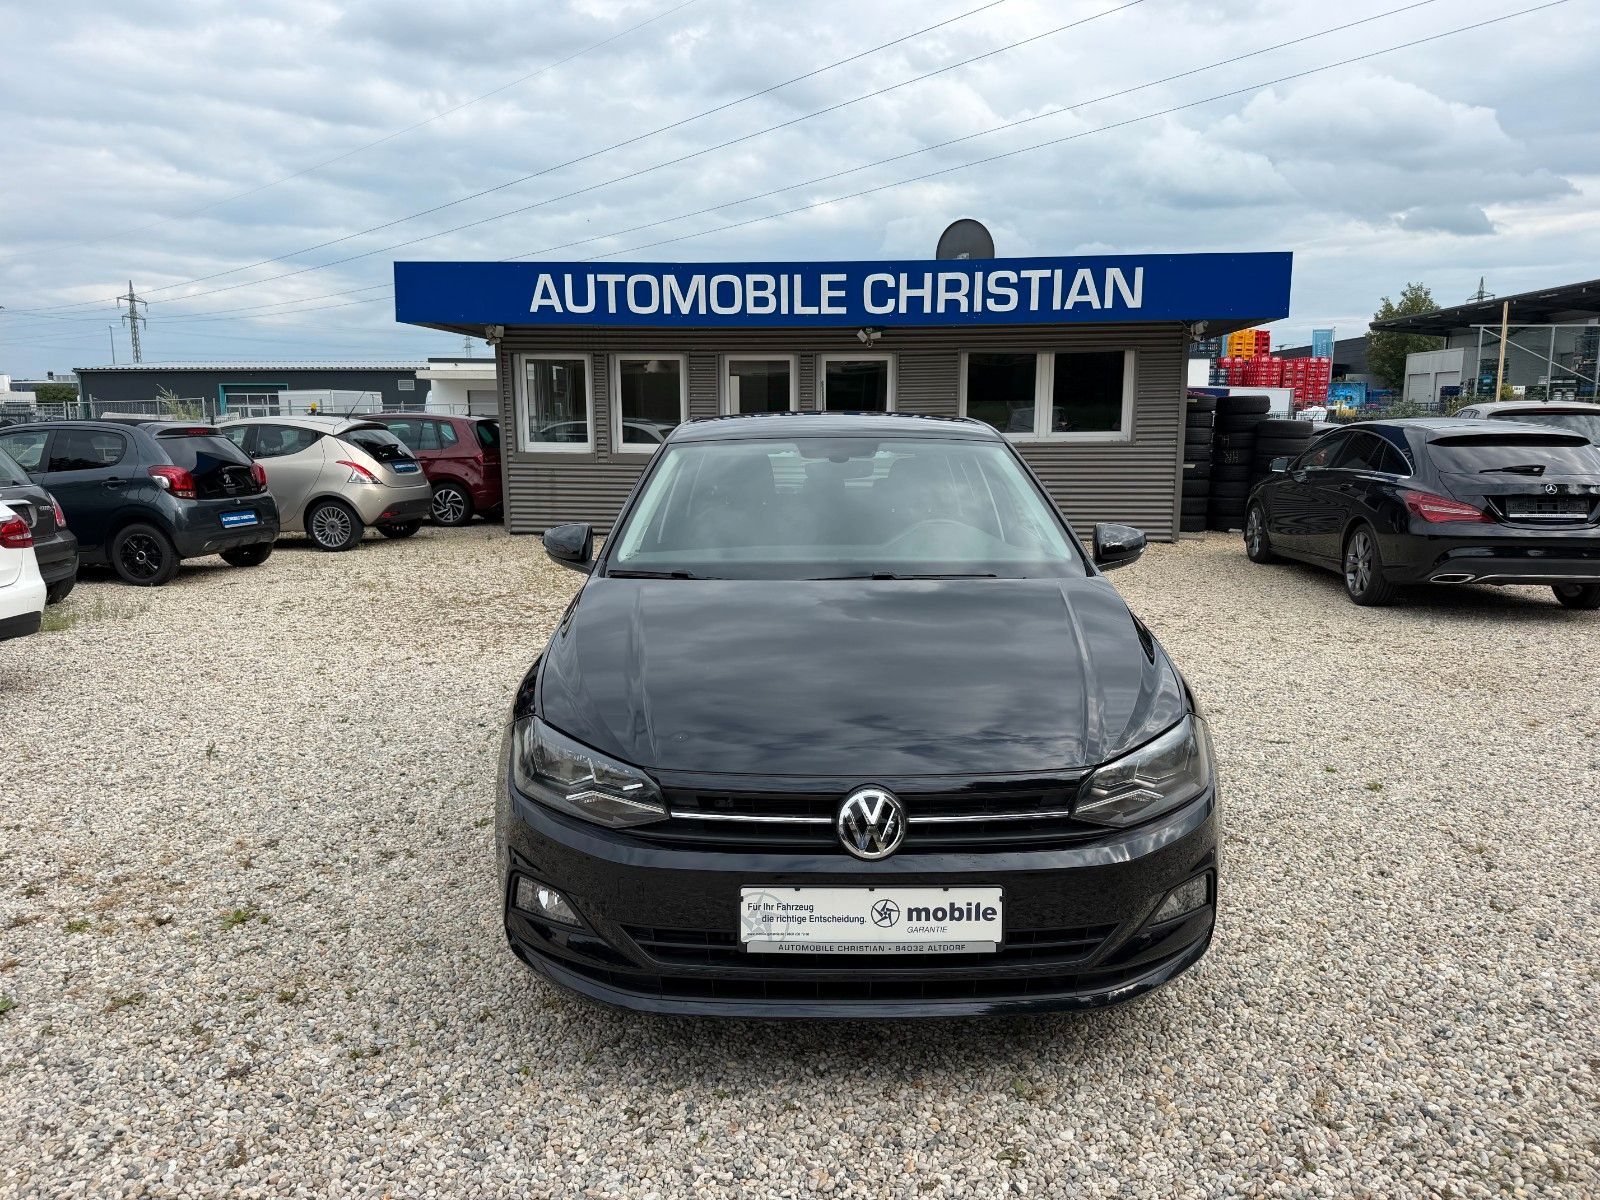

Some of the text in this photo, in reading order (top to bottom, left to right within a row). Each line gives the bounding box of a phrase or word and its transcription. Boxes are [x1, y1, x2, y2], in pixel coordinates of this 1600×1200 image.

[529, 266, 1144, 315] AUTOMOBILE CHRISTIAN
[747, 902, 814, 913] Für Ihr Fahrzeug
[907, 902, 998, 922] mobile
[761, 914, 867, 925] die richtige Entscheidung.
[906, 926, 948, 934] GARANTIE
[778, 944, 834, 952] AUTOMOBILE
[895, 944, 924, 952] 84032
[927, 944, 966, 952] ALTDORF
